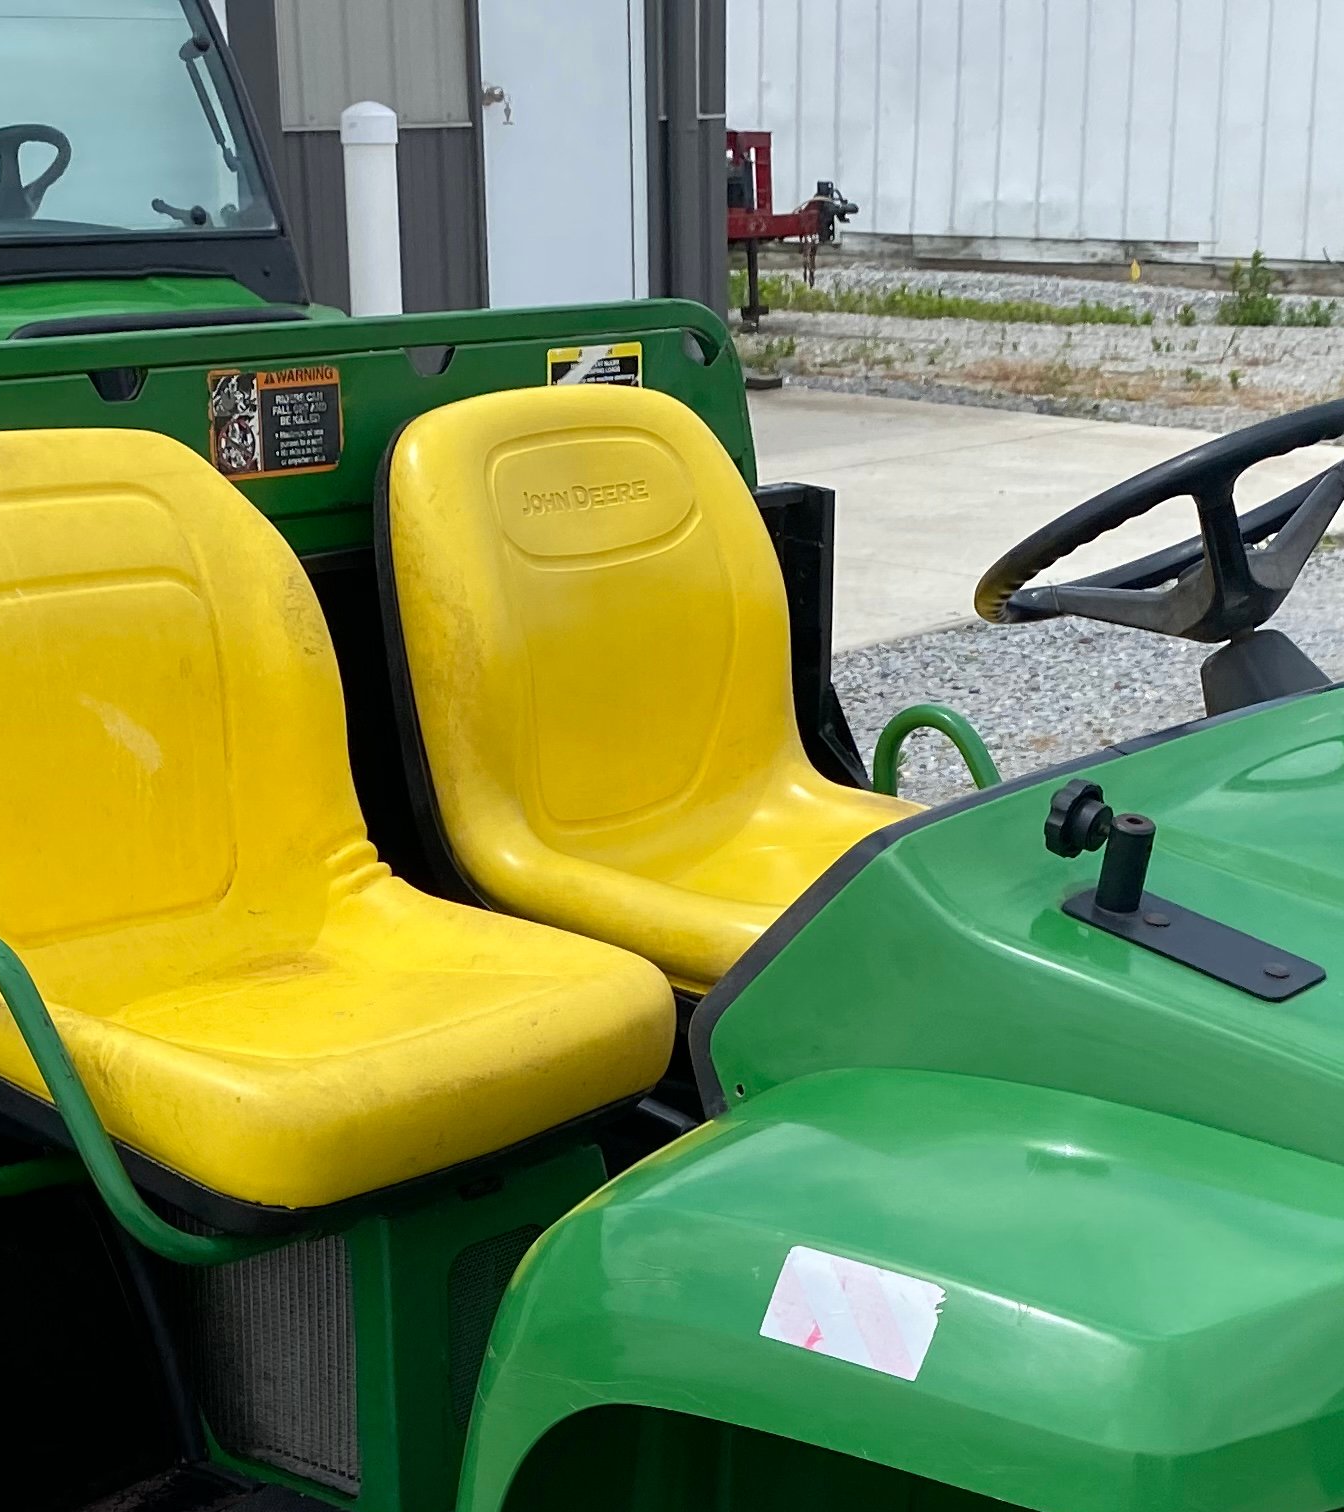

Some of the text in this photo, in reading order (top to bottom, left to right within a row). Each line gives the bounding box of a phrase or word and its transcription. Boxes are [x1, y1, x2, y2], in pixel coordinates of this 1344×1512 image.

[275, 368, 333, 383] WARNING
[272, 404, 292, 416] FALL
[522, 480, 650, 516] JOHN DEERE
